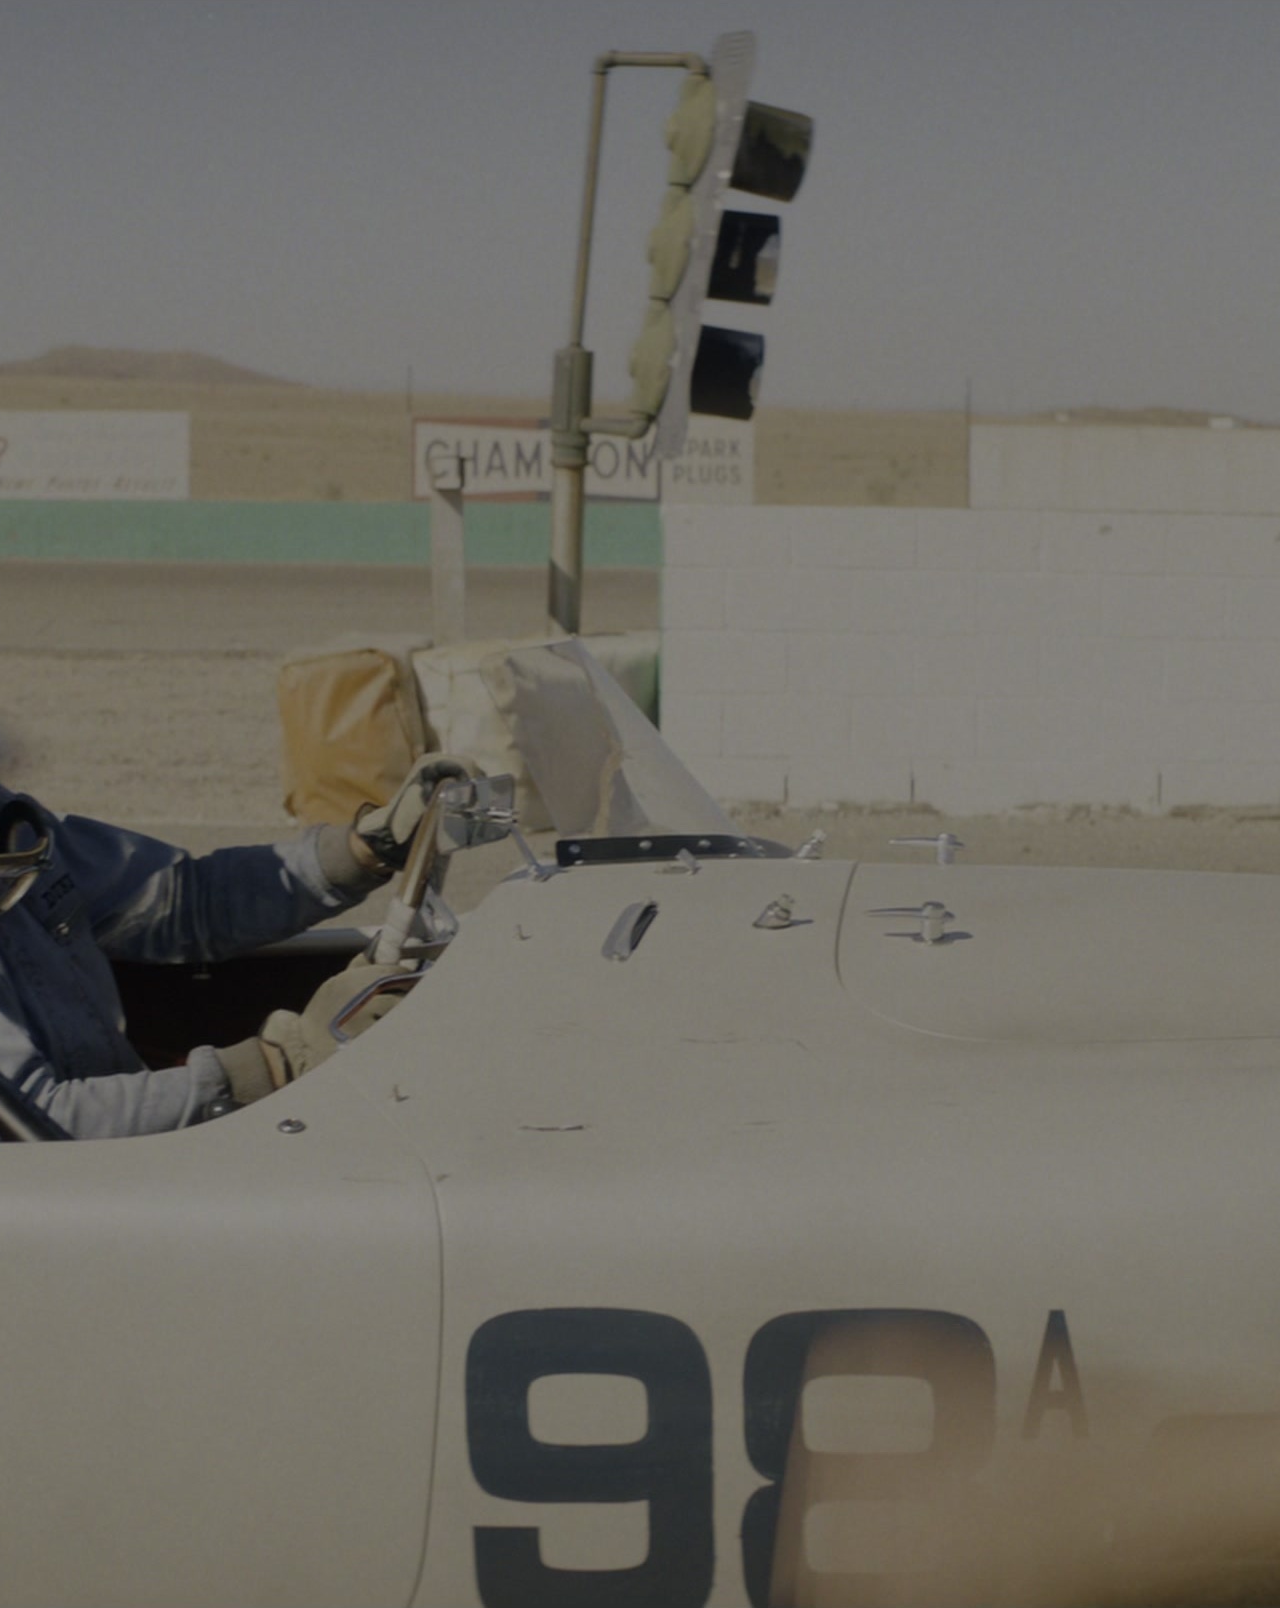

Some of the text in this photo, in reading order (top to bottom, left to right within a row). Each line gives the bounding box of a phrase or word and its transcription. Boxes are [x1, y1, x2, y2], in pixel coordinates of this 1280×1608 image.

[424, 438, 648, 480] CHAMON
[684, 438, 741, 458] PARK
[672, 463, 741, 485] PLUGS
[1021, 1309, 1088, 1440] A
[465, 1307, 996, 1608] 98
